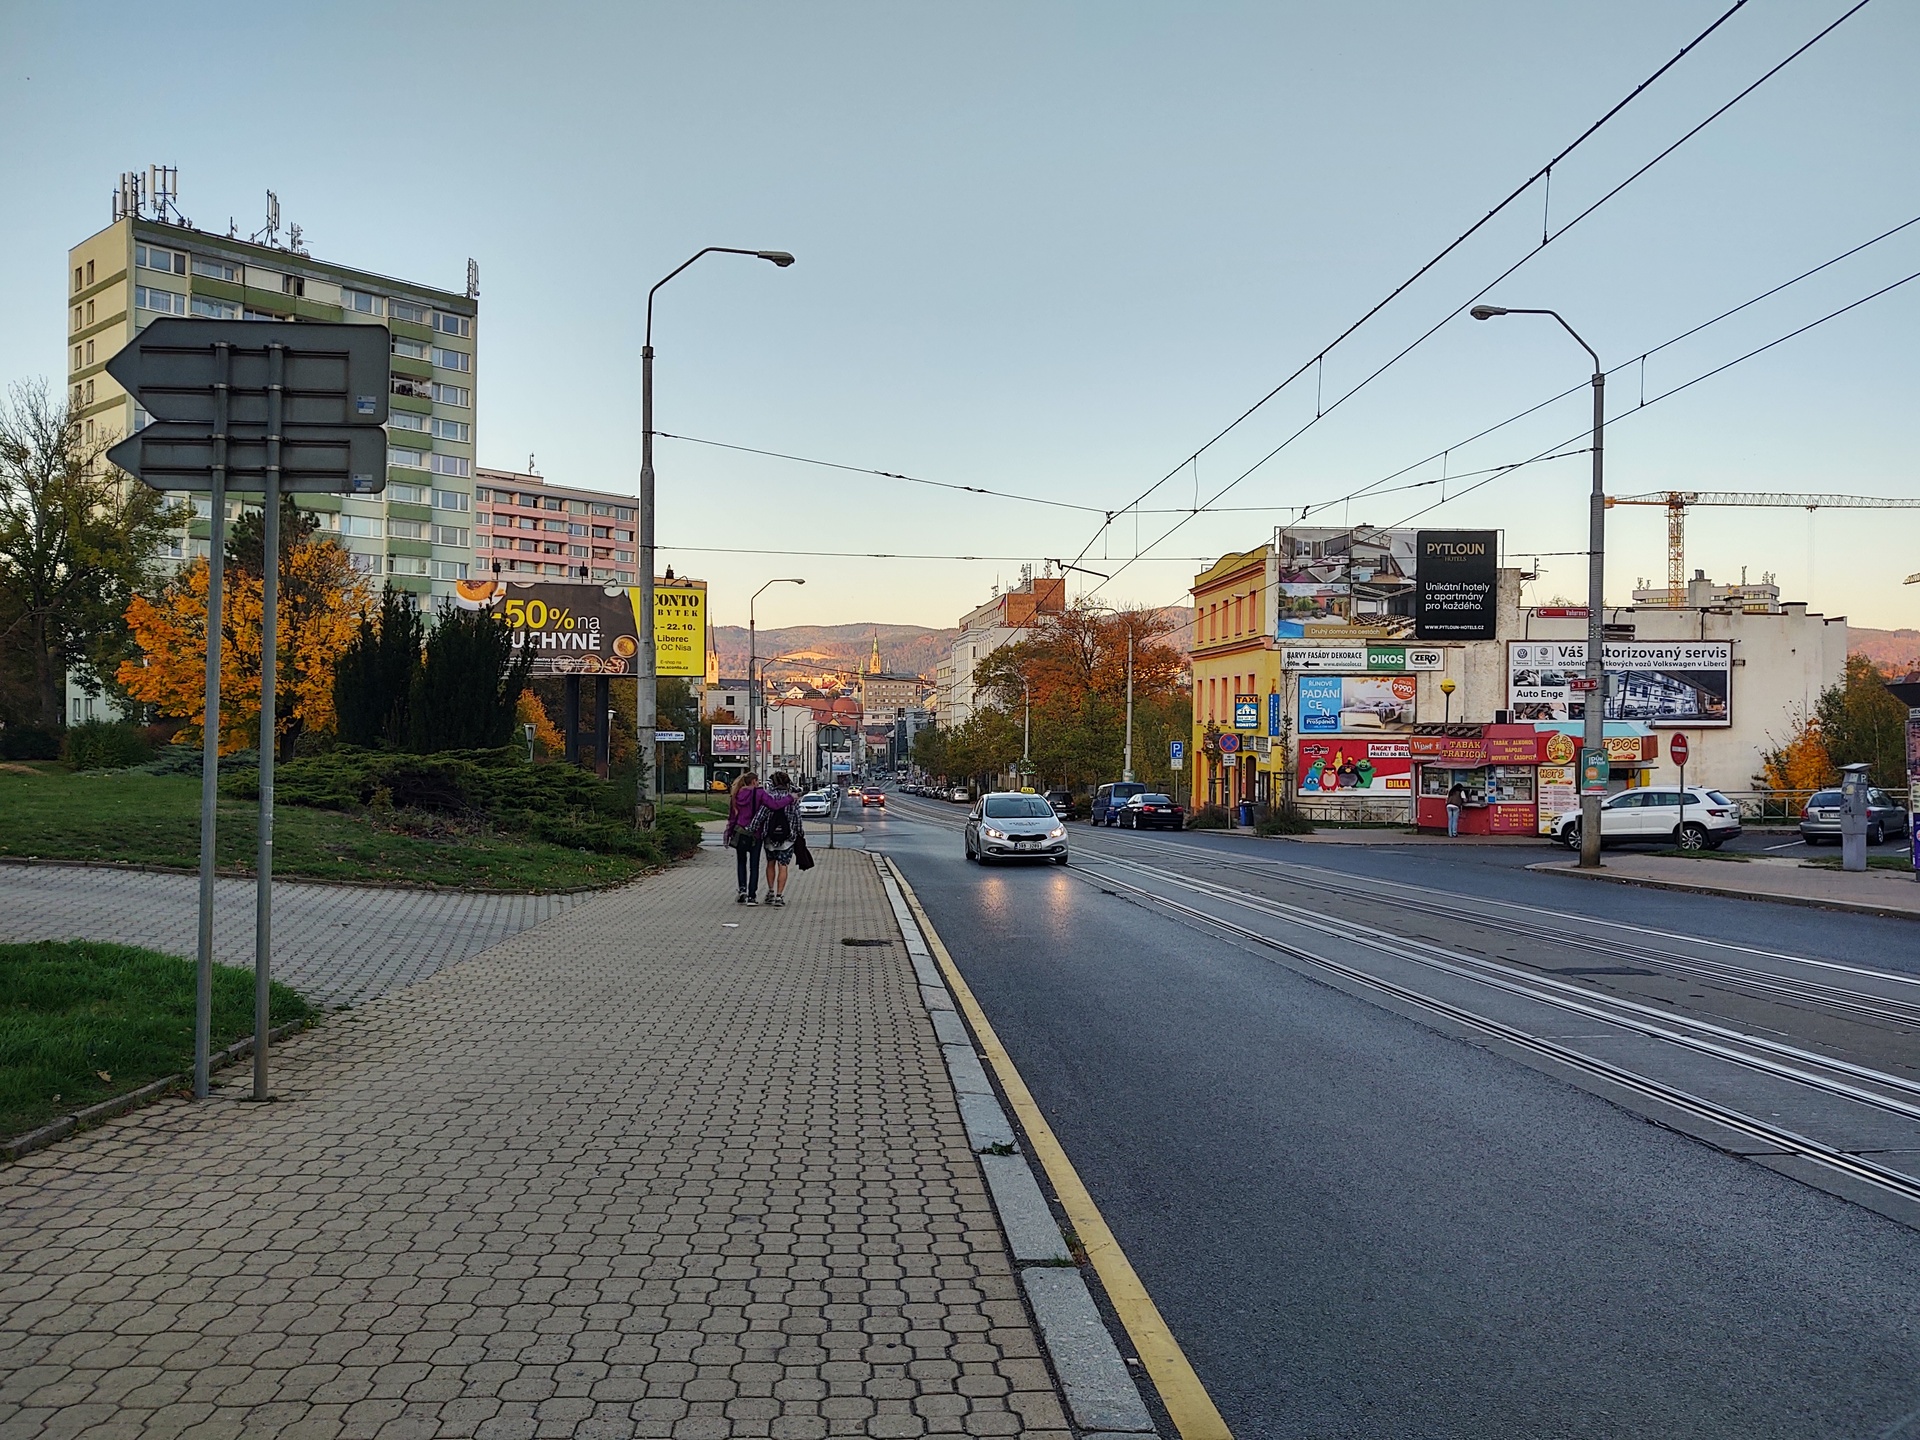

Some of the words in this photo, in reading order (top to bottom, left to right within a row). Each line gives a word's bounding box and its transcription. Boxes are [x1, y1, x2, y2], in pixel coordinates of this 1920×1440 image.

[1426, 543, 1485, 555] PYTLOUN
[1425, 582, 1461, 591] Unikátní
[1462, 582, 1490, 593] hotely
[654, 594, 699, 607] CONTO
[1434, 592, 1484, 602] apartmány
[1425, 603, 1441, 612] pro
[1442, 602, 1483, 610] každého.
[577, 616, 601, 630] na
[1311, 628, 1328, 636] Druhý
[657, 634, 689, 643] Liberec
[1286, 651, 1307, 660] BARVY
[1308, 650, 1330, 660] FASÁDY
[1331, 651, 1362, 660] DEKORACE
[1558, 645, 1584, 658] Váš
[1602, 646, 1682, 661] torizovaný
[1685, 647, 1727, 658] servis
[1369, 655, 1404, 664] OIKOS
[1414, 654, 1437, 664] ZERO
[1652, 660, 1696, 668] Volkswagen
[1301, 687, 1341, 699] PADÁNÍ
[1516, 690, 1539, 698] Auto
[1541, 690, 1564, 700] Enge
[1308, 699, 1330, 717] CEN
[1173, 744, 1181, 754] P
[1449, 740, 1481, 749] TABÁK
[1612, 738, 1641, 751] DOG
[1441, 750, 1488, 760] TRAFICON
[1539, 768, 1558, 778] HOT
[1861, 774, 1867, 783] P
[1387, 780, 1410, 788] BILLA
